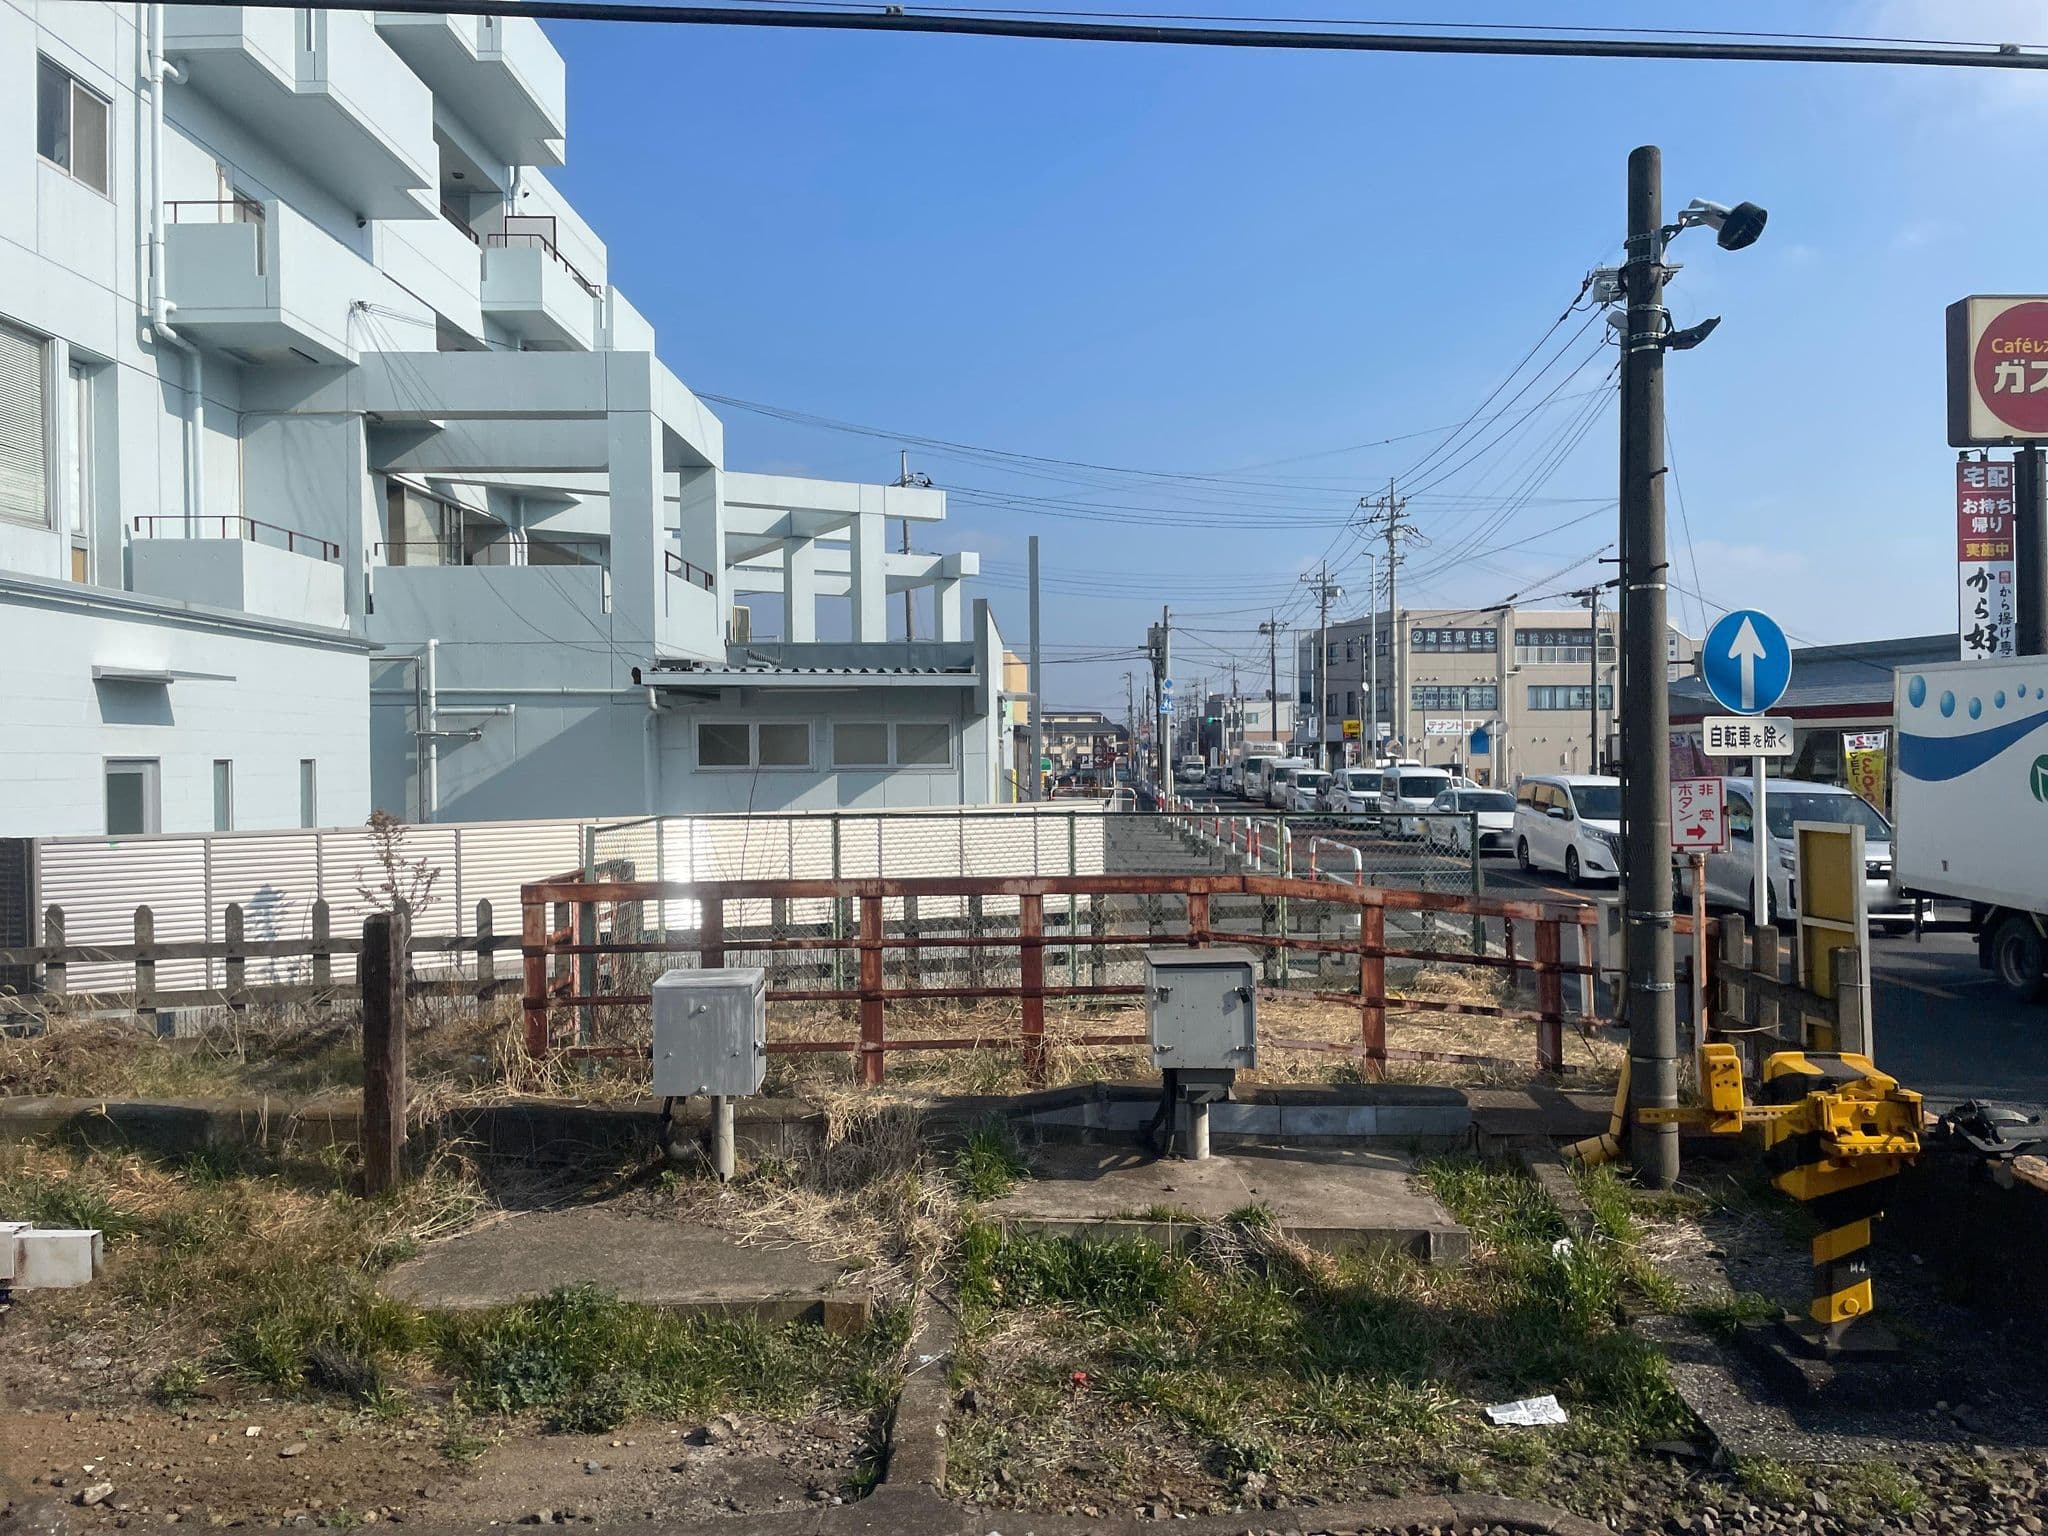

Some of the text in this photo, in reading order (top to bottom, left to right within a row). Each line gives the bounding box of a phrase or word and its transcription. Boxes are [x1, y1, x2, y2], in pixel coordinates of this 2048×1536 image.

[1963, 466, 2009, 488] 宅配
[1962, 498, 2011, 514] お持ち
[1971, 516, 2002, 533] 帰り
[1966, 542, 2009, 557] 実施中
[1964, 566, 2000, 659] から好
[1998, 586, 2013, 658] から揚げ専
[1426, 630, 1495, 644] 埼玉県住宅
[1516, 632, 1567, 645] 供給公社
[1710, 724, 1787, 749] 自転車を除く
[1677, 783, 1694, 822] ボタン
[1698, 783, 1715, 822] 非常
